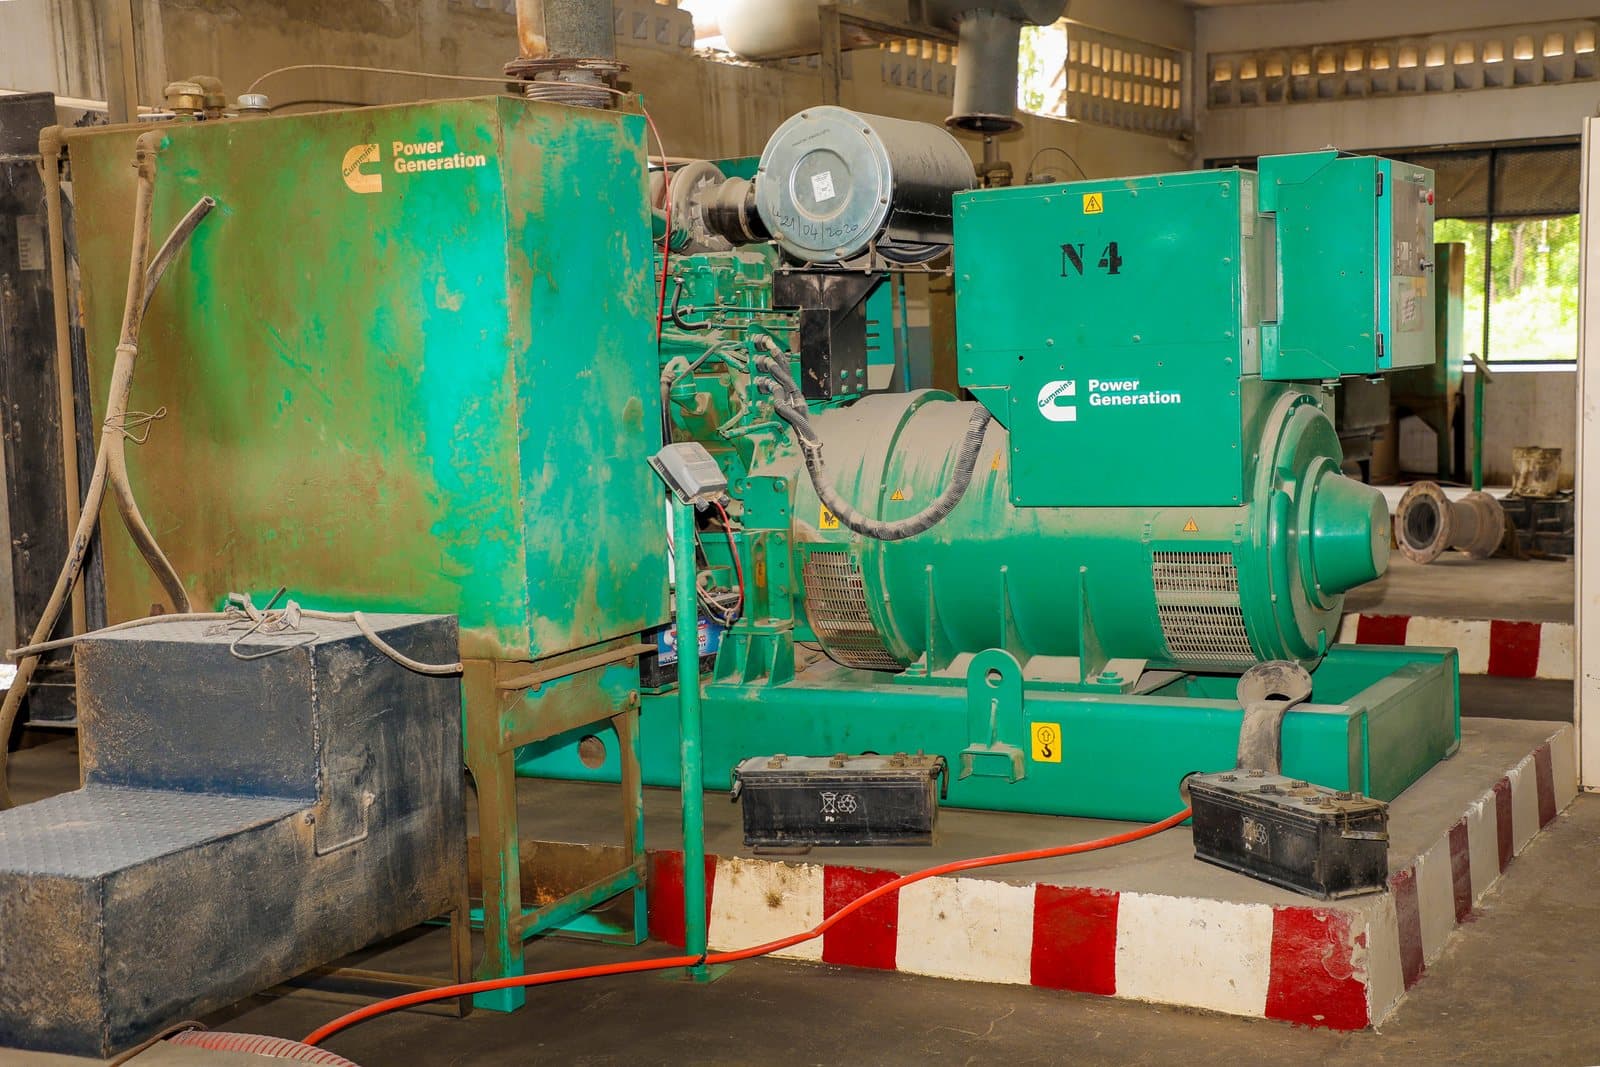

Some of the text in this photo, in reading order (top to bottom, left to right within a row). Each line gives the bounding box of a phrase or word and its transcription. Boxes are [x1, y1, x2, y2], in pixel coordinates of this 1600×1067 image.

[392, 141, 443, 155] Power
[343, 144, 376, 177] Cummins
[394, 153, 486, 173] Generation
[1060, 241, 1122, 277] N 4
[1038, 380, 1073, 408] Cummins
[1088, 379, 1140, 392] Power
[1089, 391, 1181, 406] Generation
